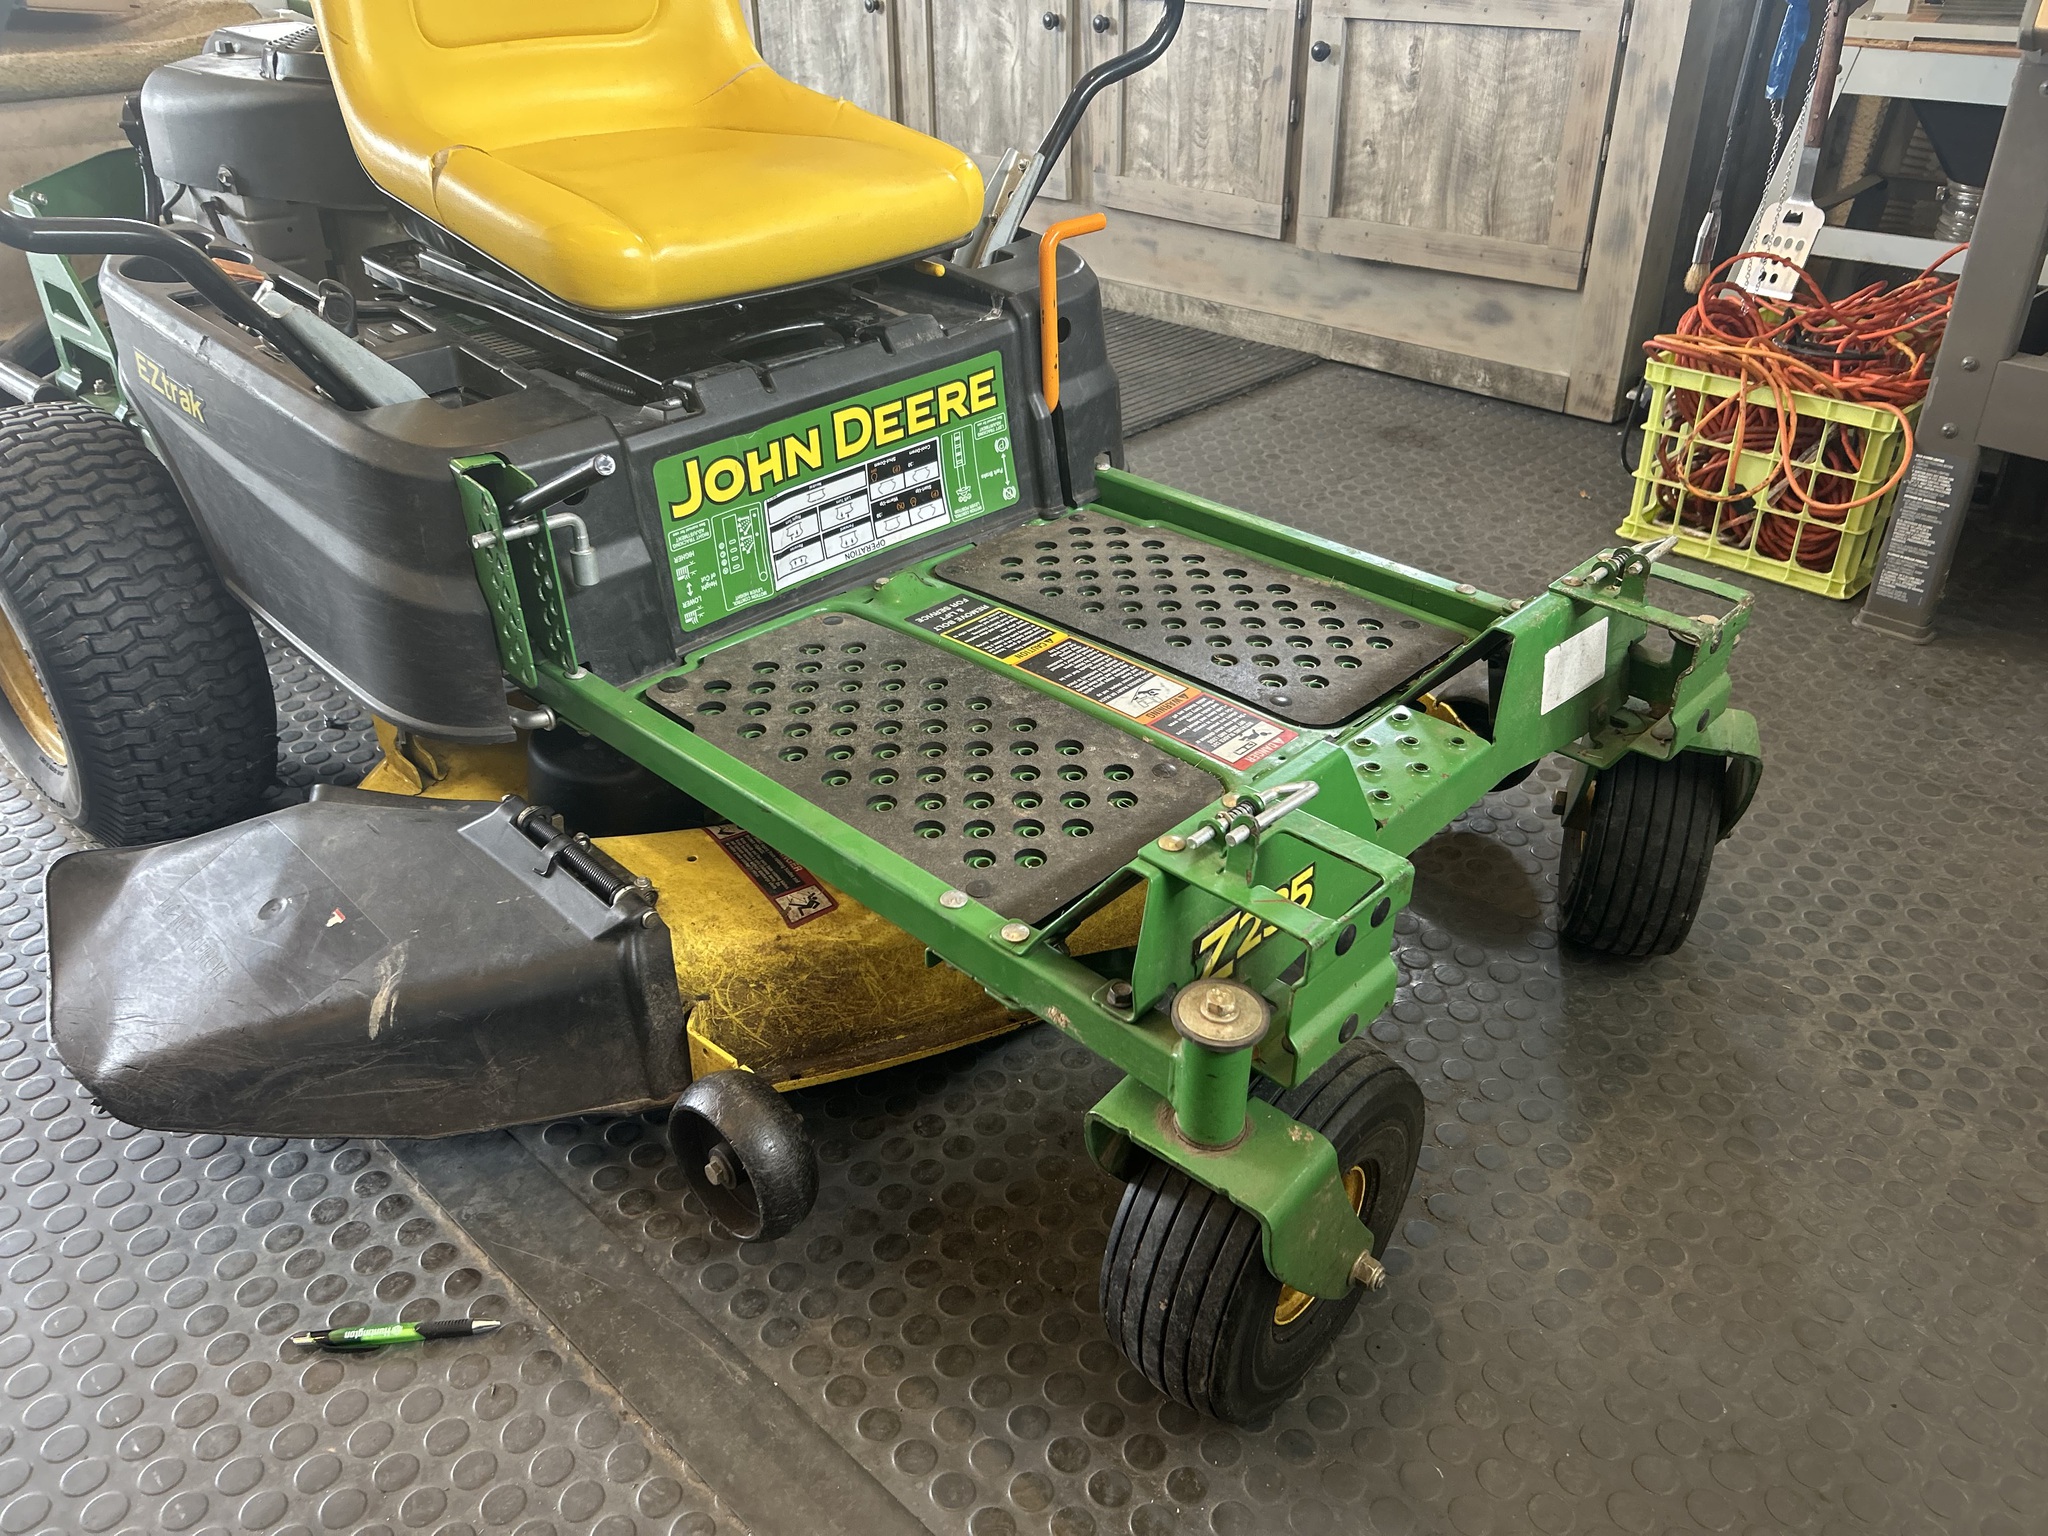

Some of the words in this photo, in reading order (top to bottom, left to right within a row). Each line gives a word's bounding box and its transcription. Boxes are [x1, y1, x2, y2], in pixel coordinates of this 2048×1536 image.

[134, 350, 205, 423] EZtrak
[671, 425, 823, 521] JOHN
[831, 368, 998, 461] DEERE
[909, 445, 931, 455] Cool-Down
[874, 457, 896, 467] Shut-Down
[981, 471, 993, 479] Brake
[915, 484, 932, 493] Start-Up
[880, 497, 899, 507] Warm-Up
[675, 528, 705, 542] ADJUSTMENT
[672, 538, 695, 549] TRACKING
[845, 540, 886, 559] OPERATION
[674, 550, 695, 563] HIGHER
[701, 580, 717, 591] Height
[682, 596, 702, 608] LOWER
[950, 598, 969, 608] FOR
[915, 606, 951, 623] SERVICE
[939, 611, 958, 621] LIFT
[954, 604, 989, 622] REMOVE
[933, 620, 956, 631] BOLT
[1014, 642, 1047, 659] CAUTION
[1145, 699, 1183, 718] WARNING
[1245, 742, 1279, 762] DANGER
[187, 936, 234, 984] REMOVE
[344, 1325, 394, 1339] Huntington
